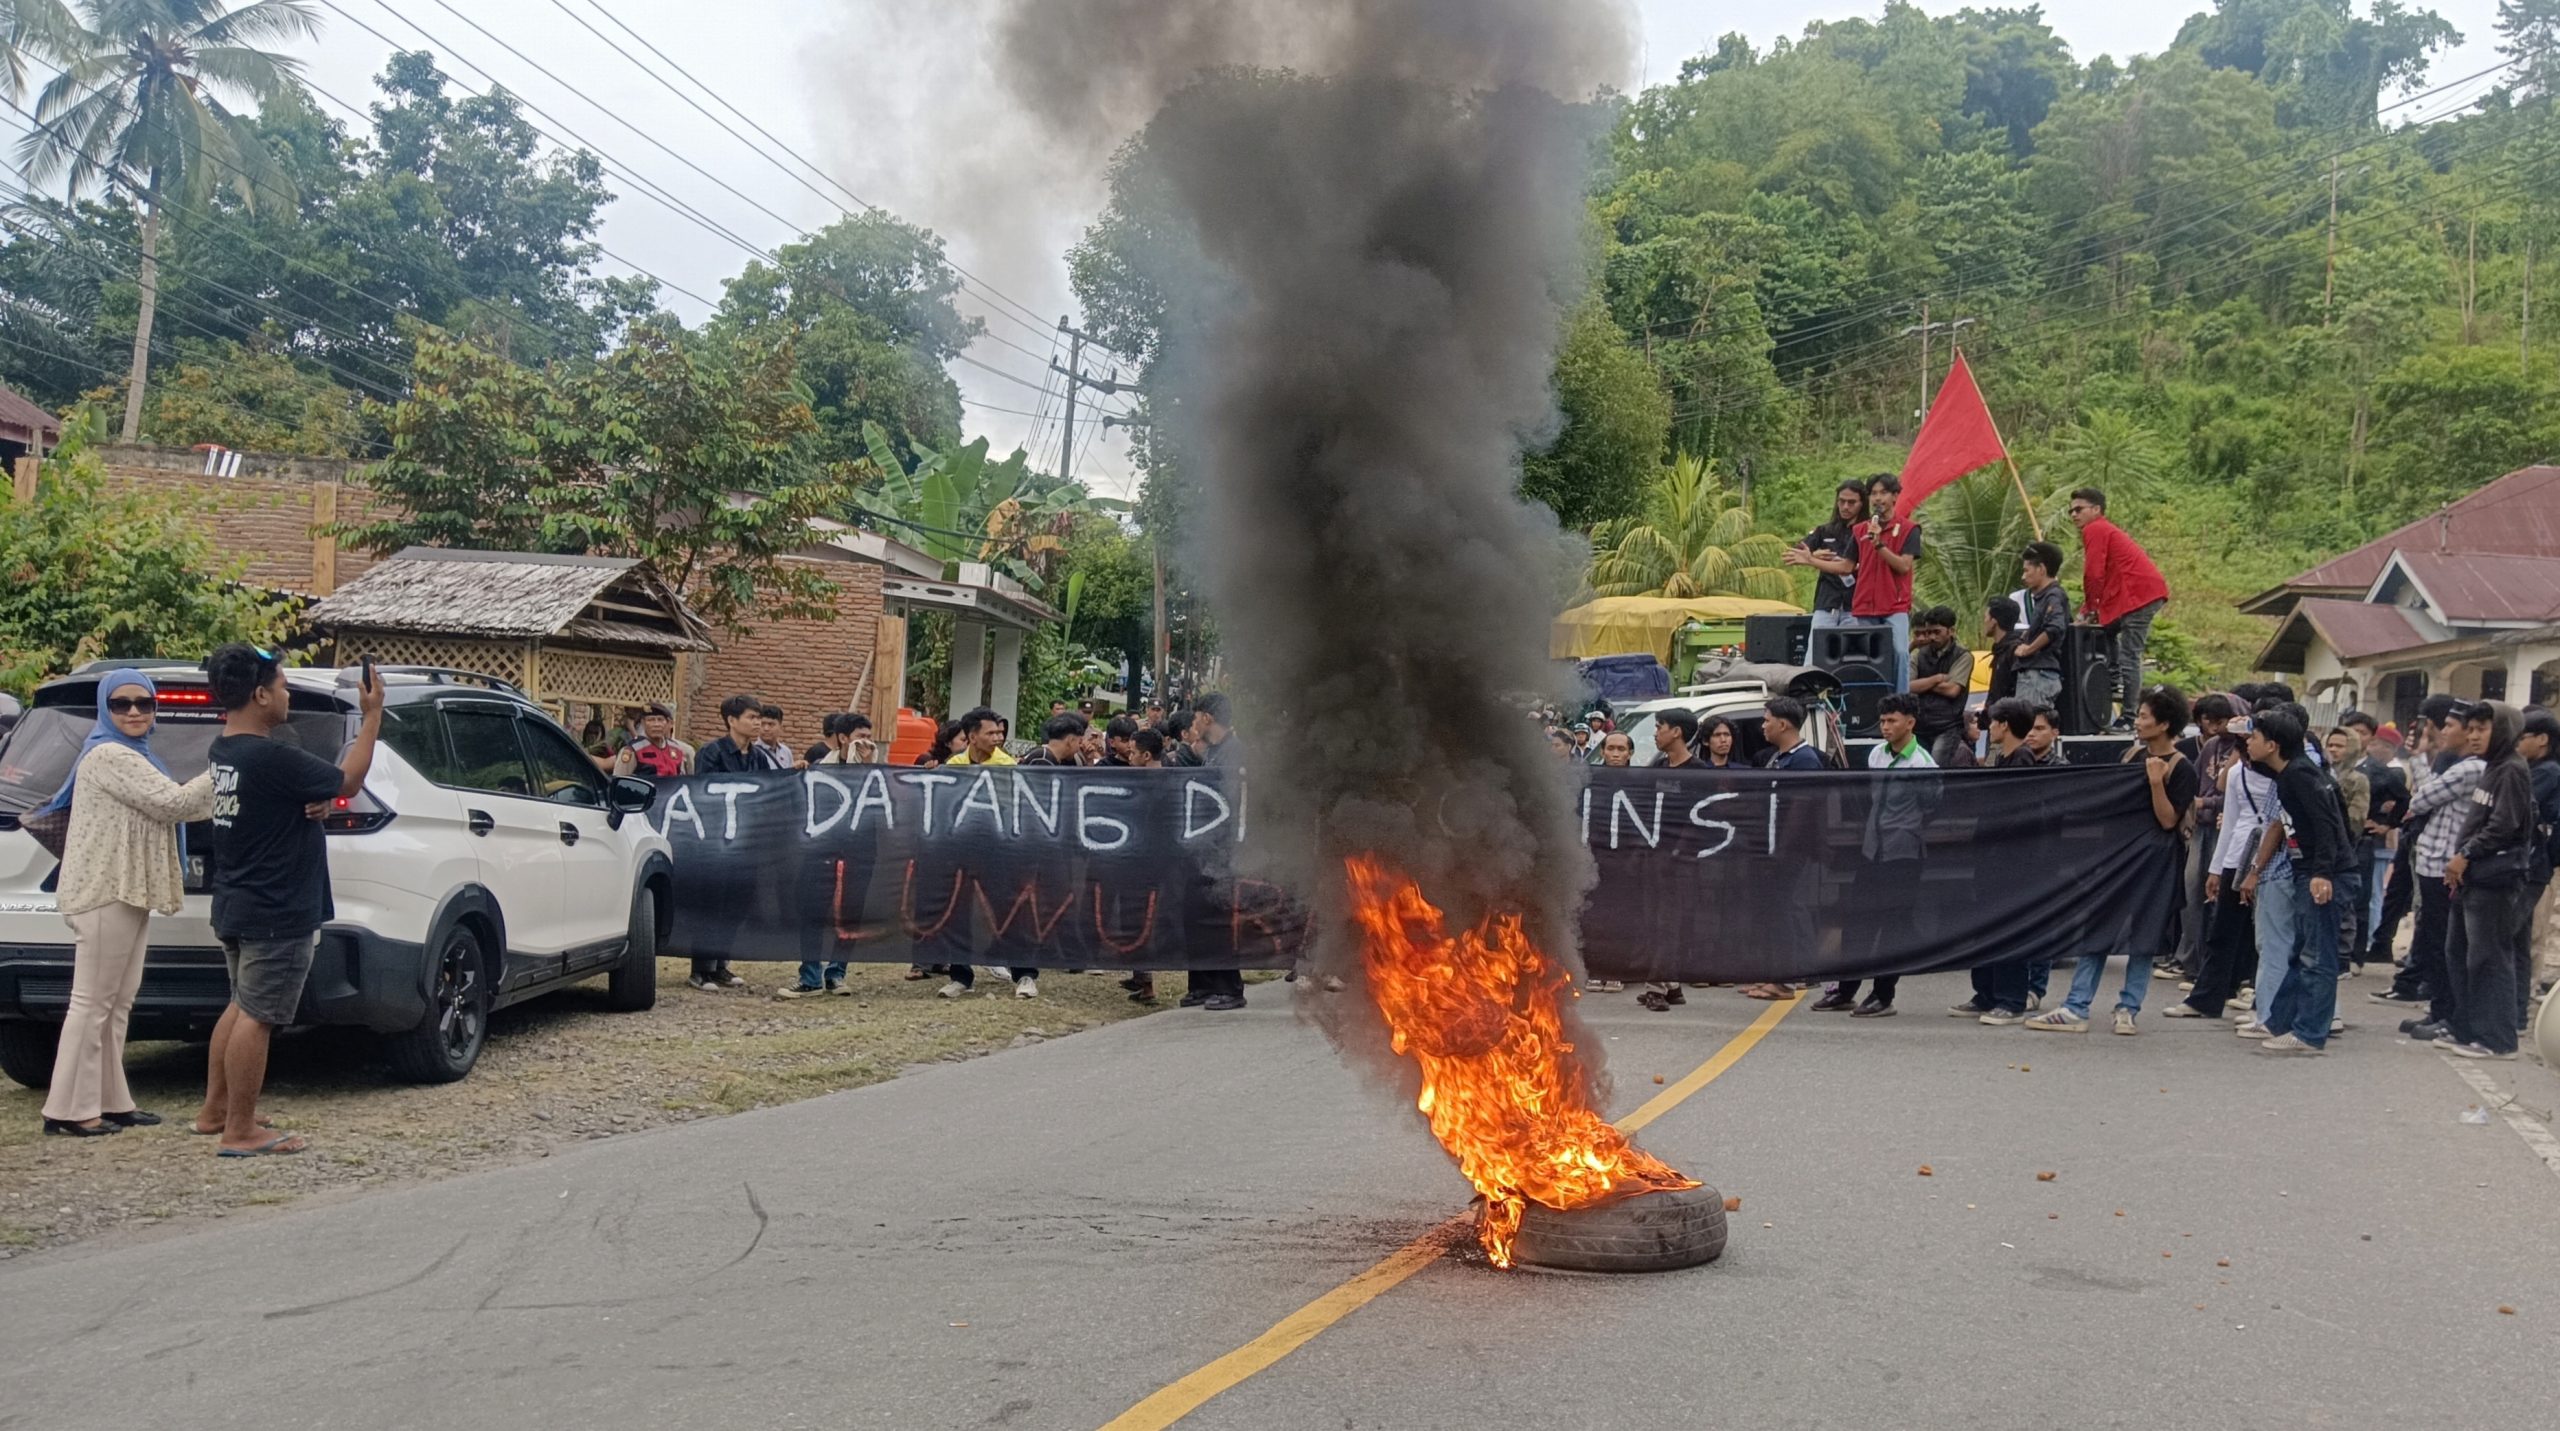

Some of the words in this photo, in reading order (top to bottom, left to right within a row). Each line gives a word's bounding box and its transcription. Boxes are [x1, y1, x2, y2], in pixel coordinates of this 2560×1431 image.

[660, 783, 761, 841] AT
[803, 768, 1132, 850] DATANG
[832, 859, 1157, 952] LUWU
